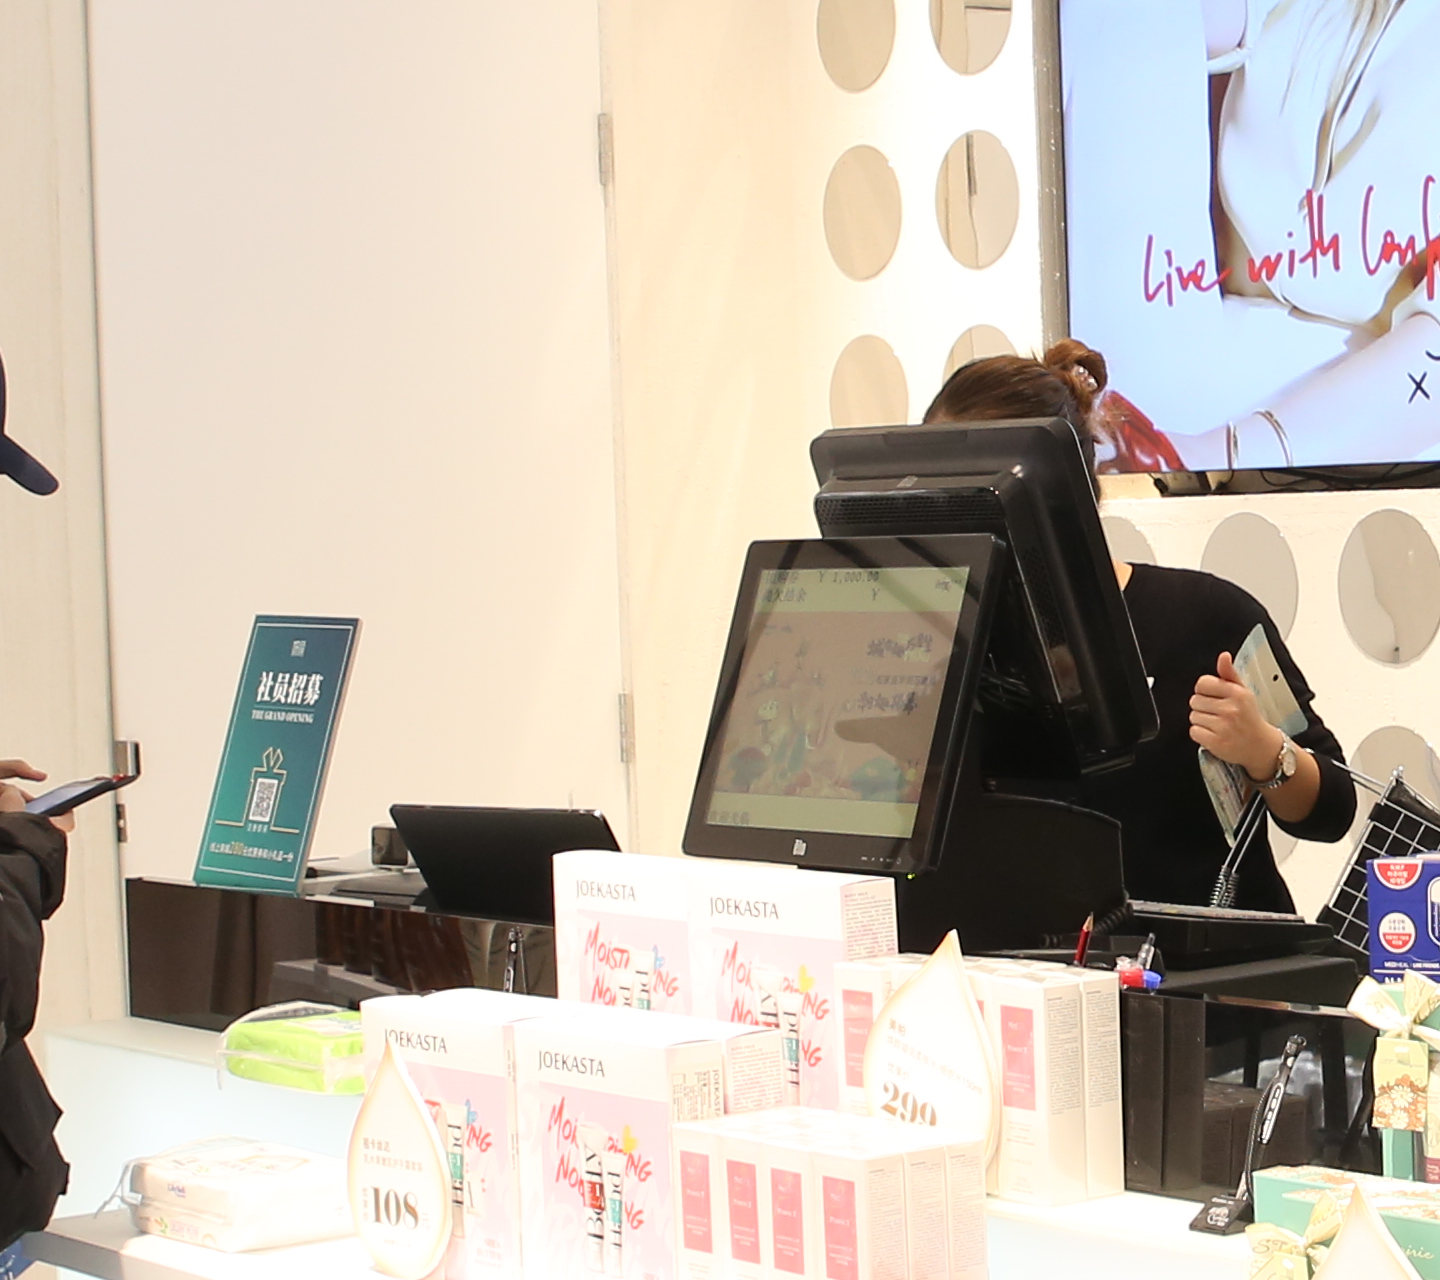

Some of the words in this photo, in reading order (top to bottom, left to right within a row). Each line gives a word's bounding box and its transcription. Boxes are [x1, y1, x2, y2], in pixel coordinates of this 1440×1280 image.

[1143, 233, 1232, 307] Live
[1247, 188, 1340, 283] with
[255, 671, 324, 706] 社员招募
[576, 879, 636, 902] JOEKASTA
[710, 896, 779, 920] JOEKASTA
[538, 1050, 606, 1078] JOEKASTA
[370, 1185, 420, 1230] 108
